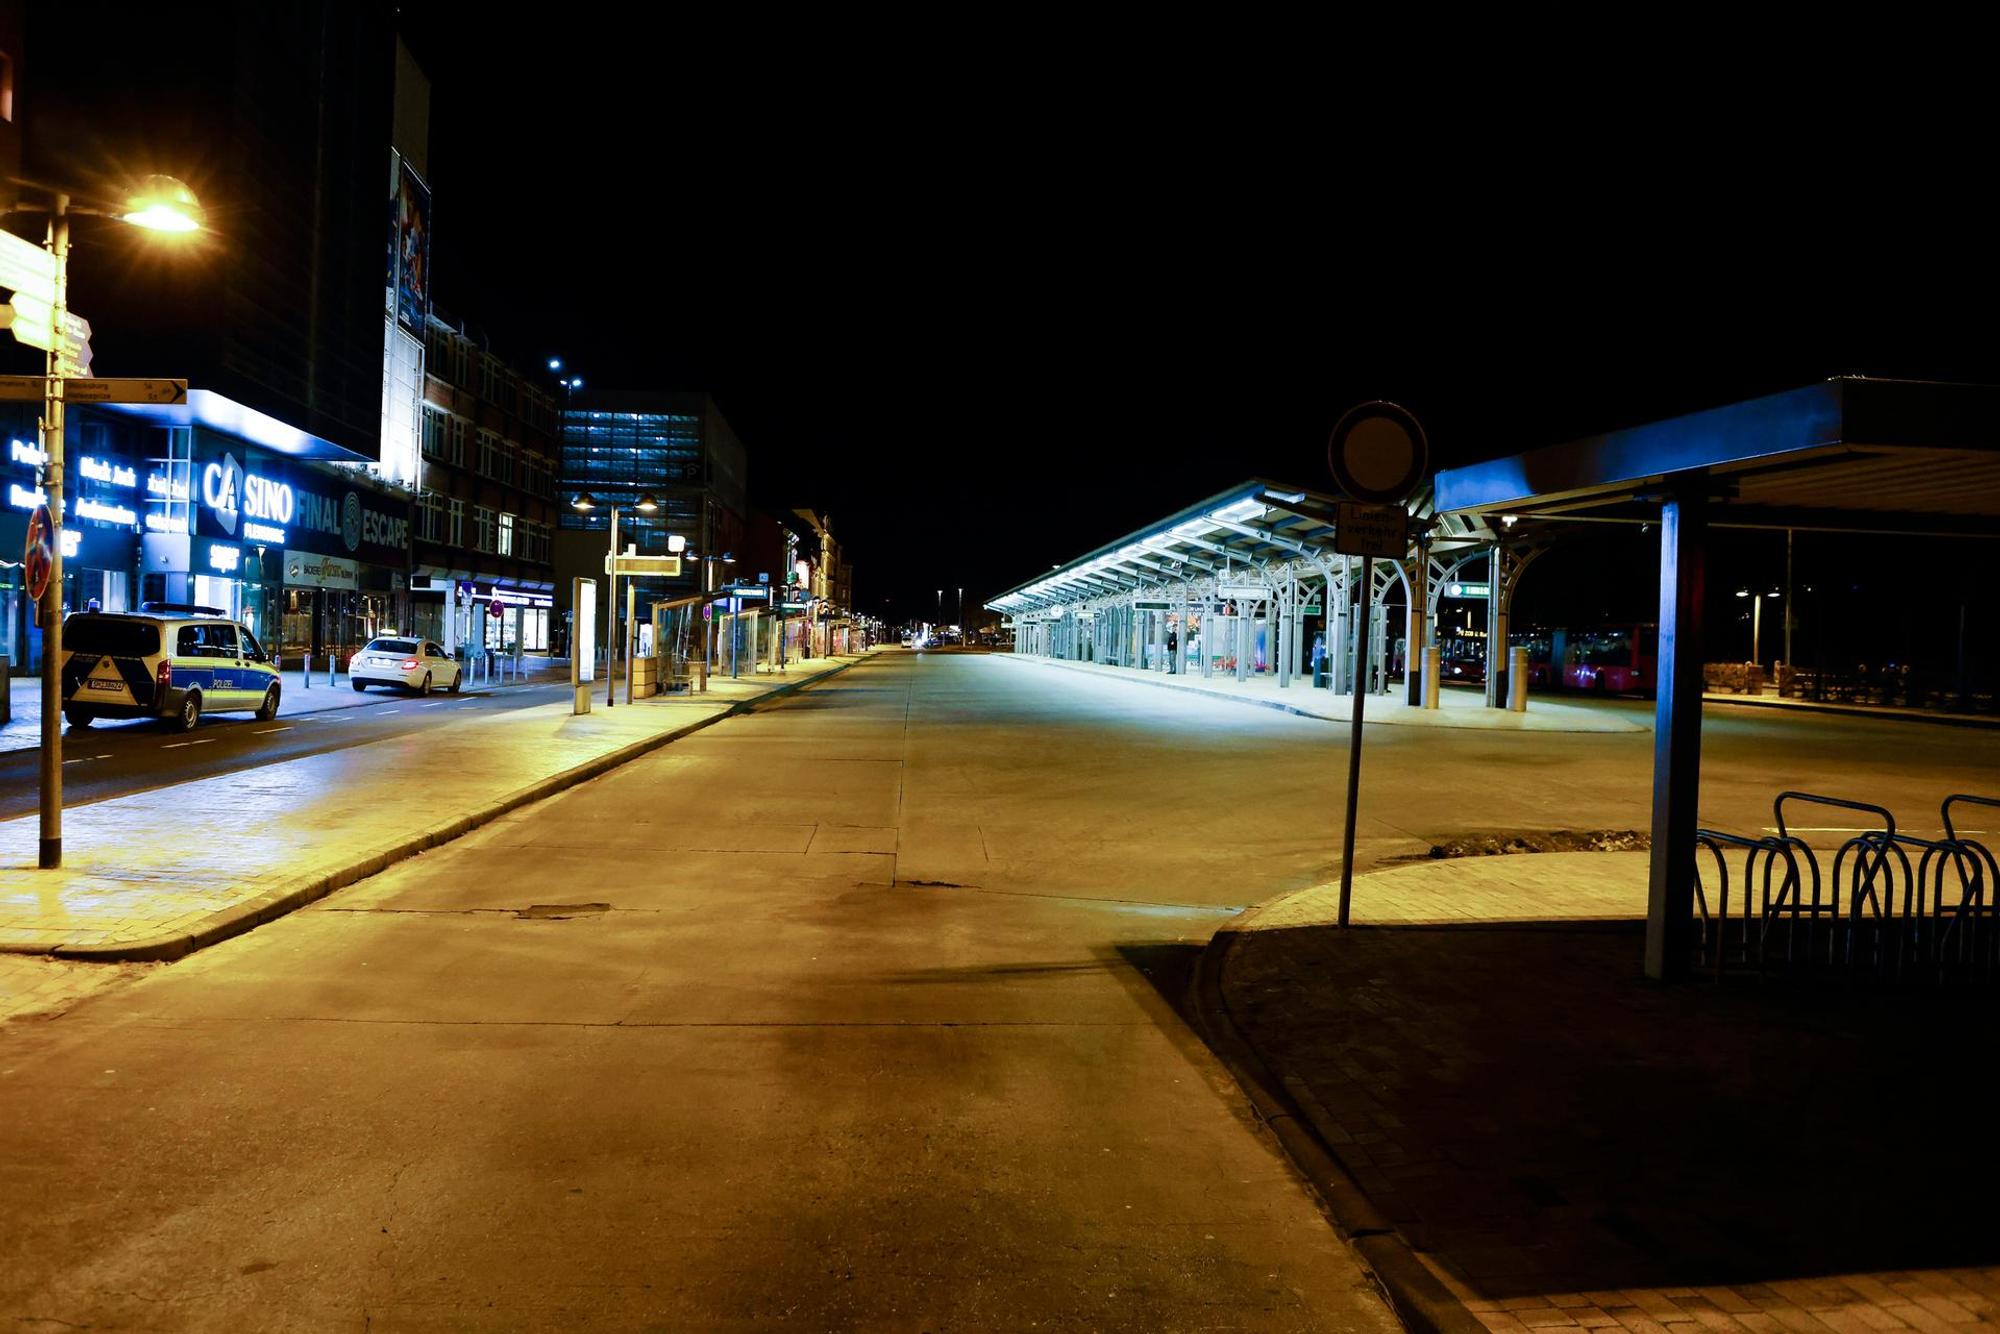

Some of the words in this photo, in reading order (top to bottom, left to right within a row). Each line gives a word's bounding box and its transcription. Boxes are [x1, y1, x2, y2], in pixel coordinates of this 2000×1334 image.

[203, 463, 293, 524] CASINO
[297, 490, 342, 535] FINAL
[362, 509, 409, 550] ESCAPE
[212, 679, 233, 689] POLIZEI
